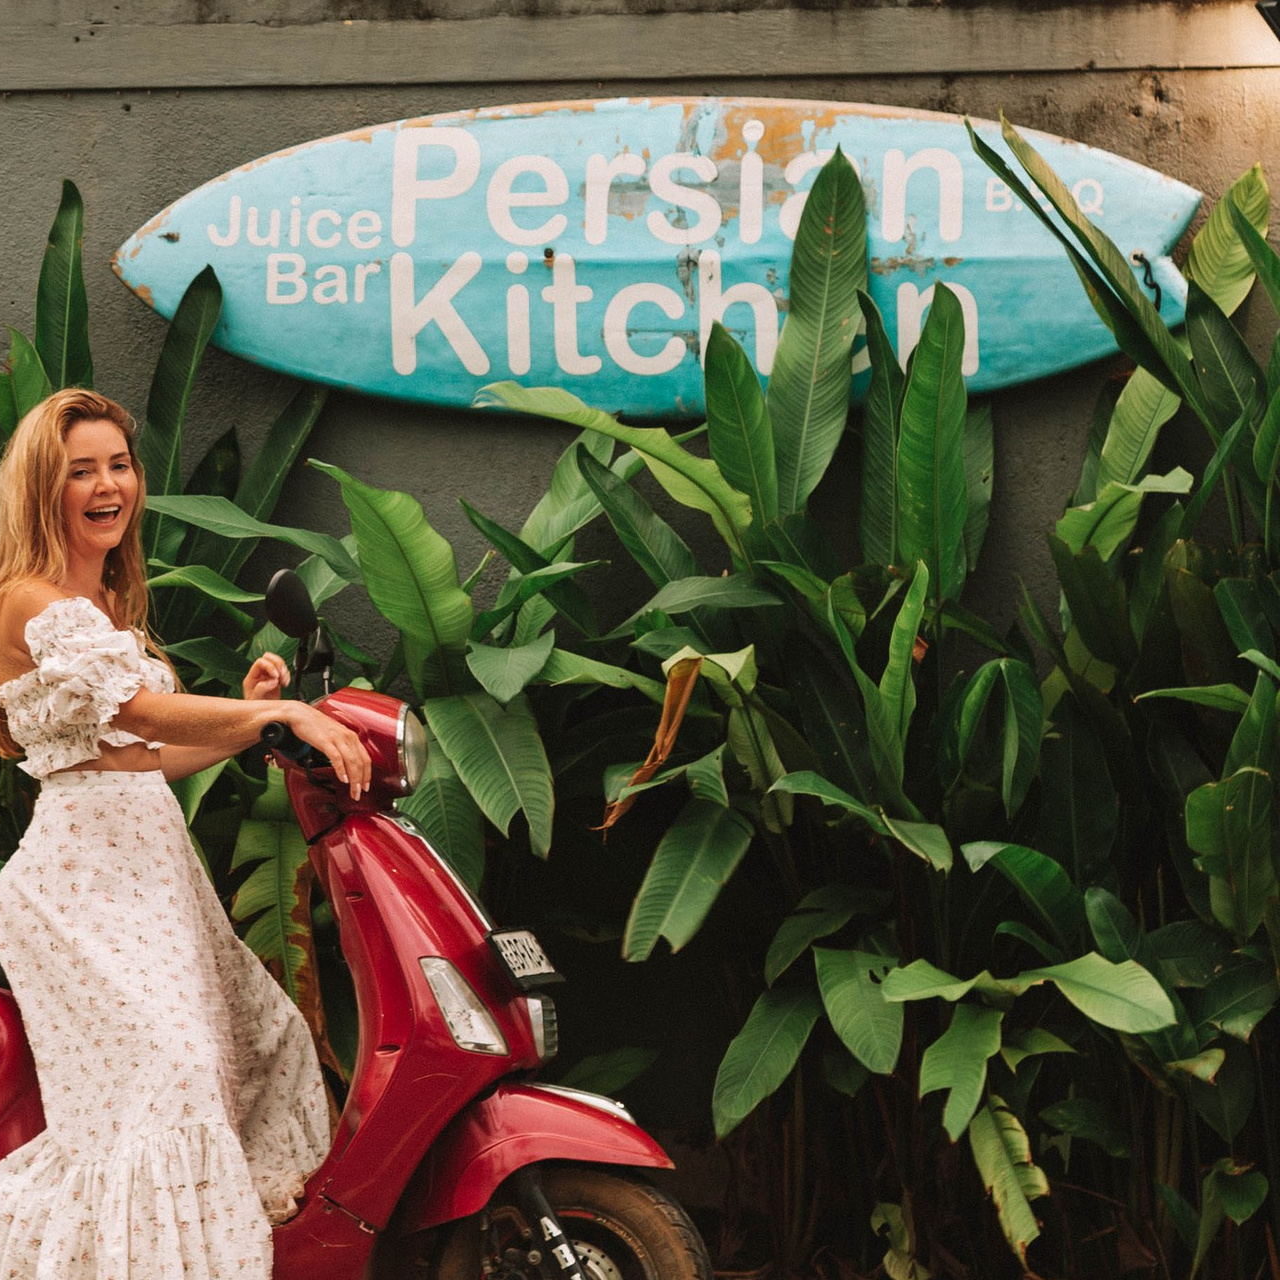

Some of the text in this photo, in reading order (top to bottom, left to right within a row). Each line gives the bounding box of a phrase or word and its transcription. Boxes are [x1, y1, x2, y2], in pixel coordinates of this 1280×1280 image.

[206, 195, 383, 249] Juice
[266, 252, 382, 305] Bar
[390, 250, 980, 377] Kitchn
